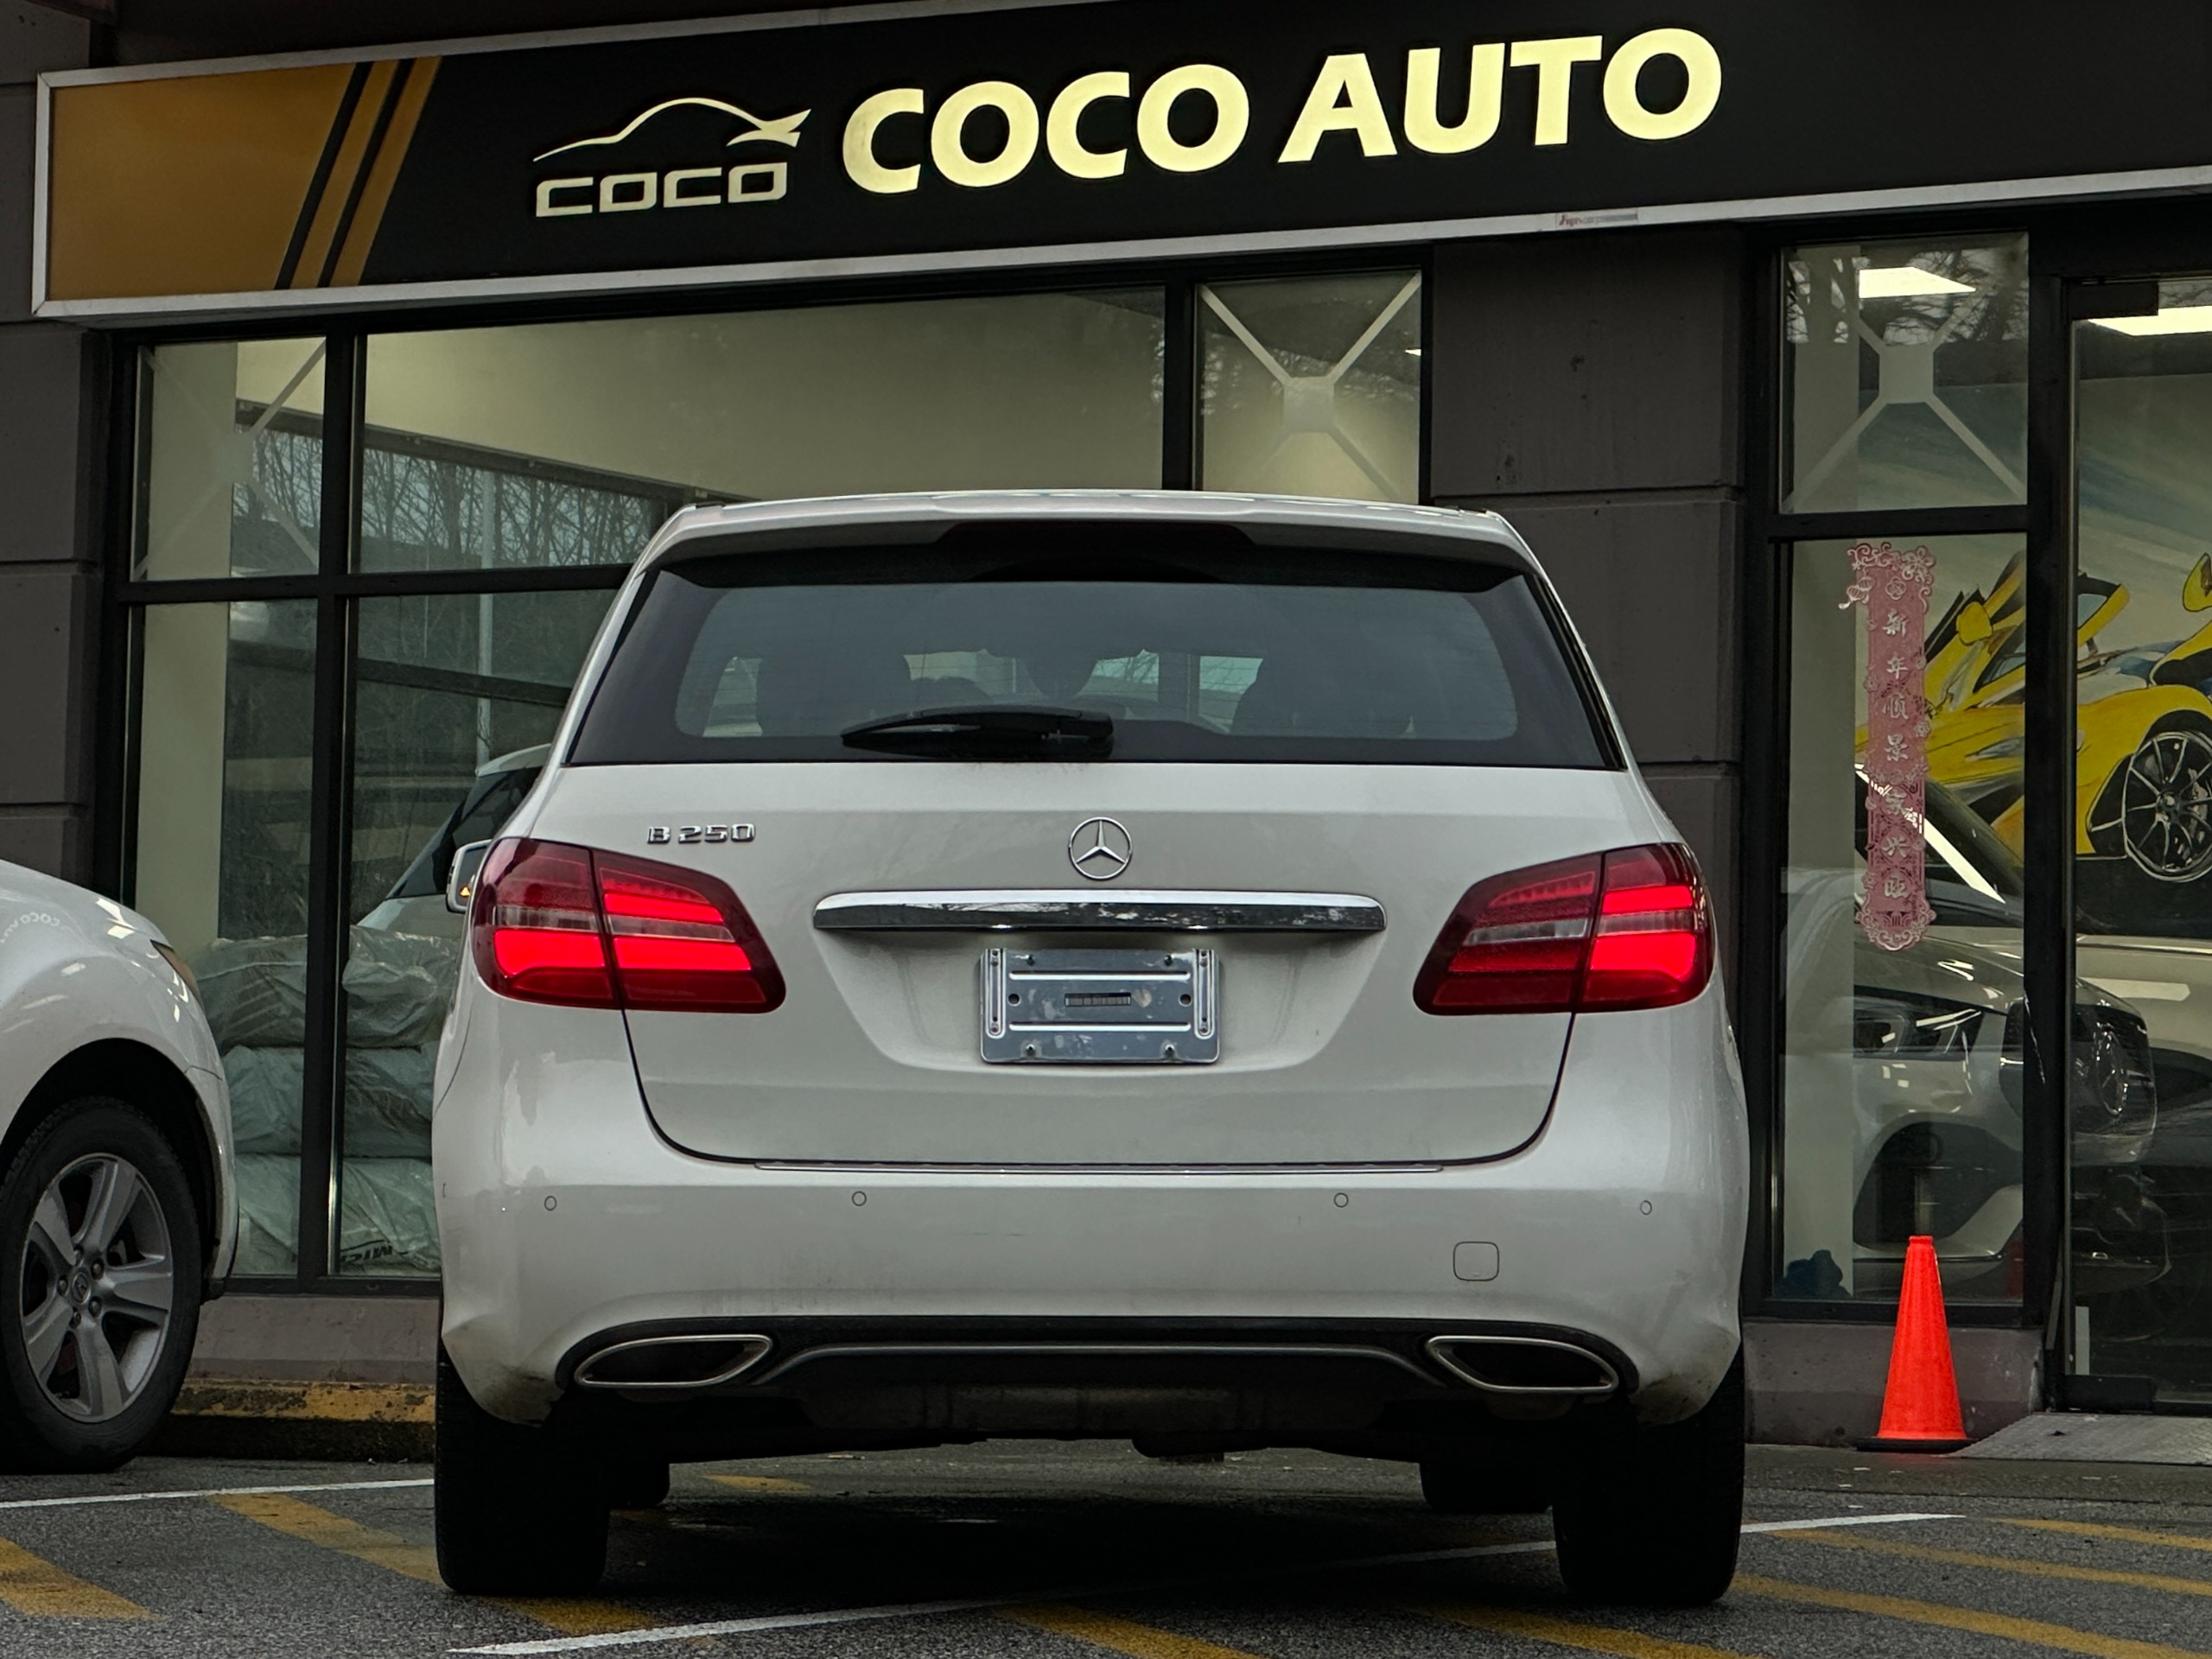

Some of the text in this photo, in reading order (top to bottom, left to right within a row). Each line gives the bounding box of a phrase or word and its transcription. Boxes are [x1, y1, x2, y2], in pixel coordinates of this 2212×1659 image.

[842, 27, 1723, 194] COCO AUTO
[534, 162, 788, 218] COCO
[647, 823, 756, 844] B 250
